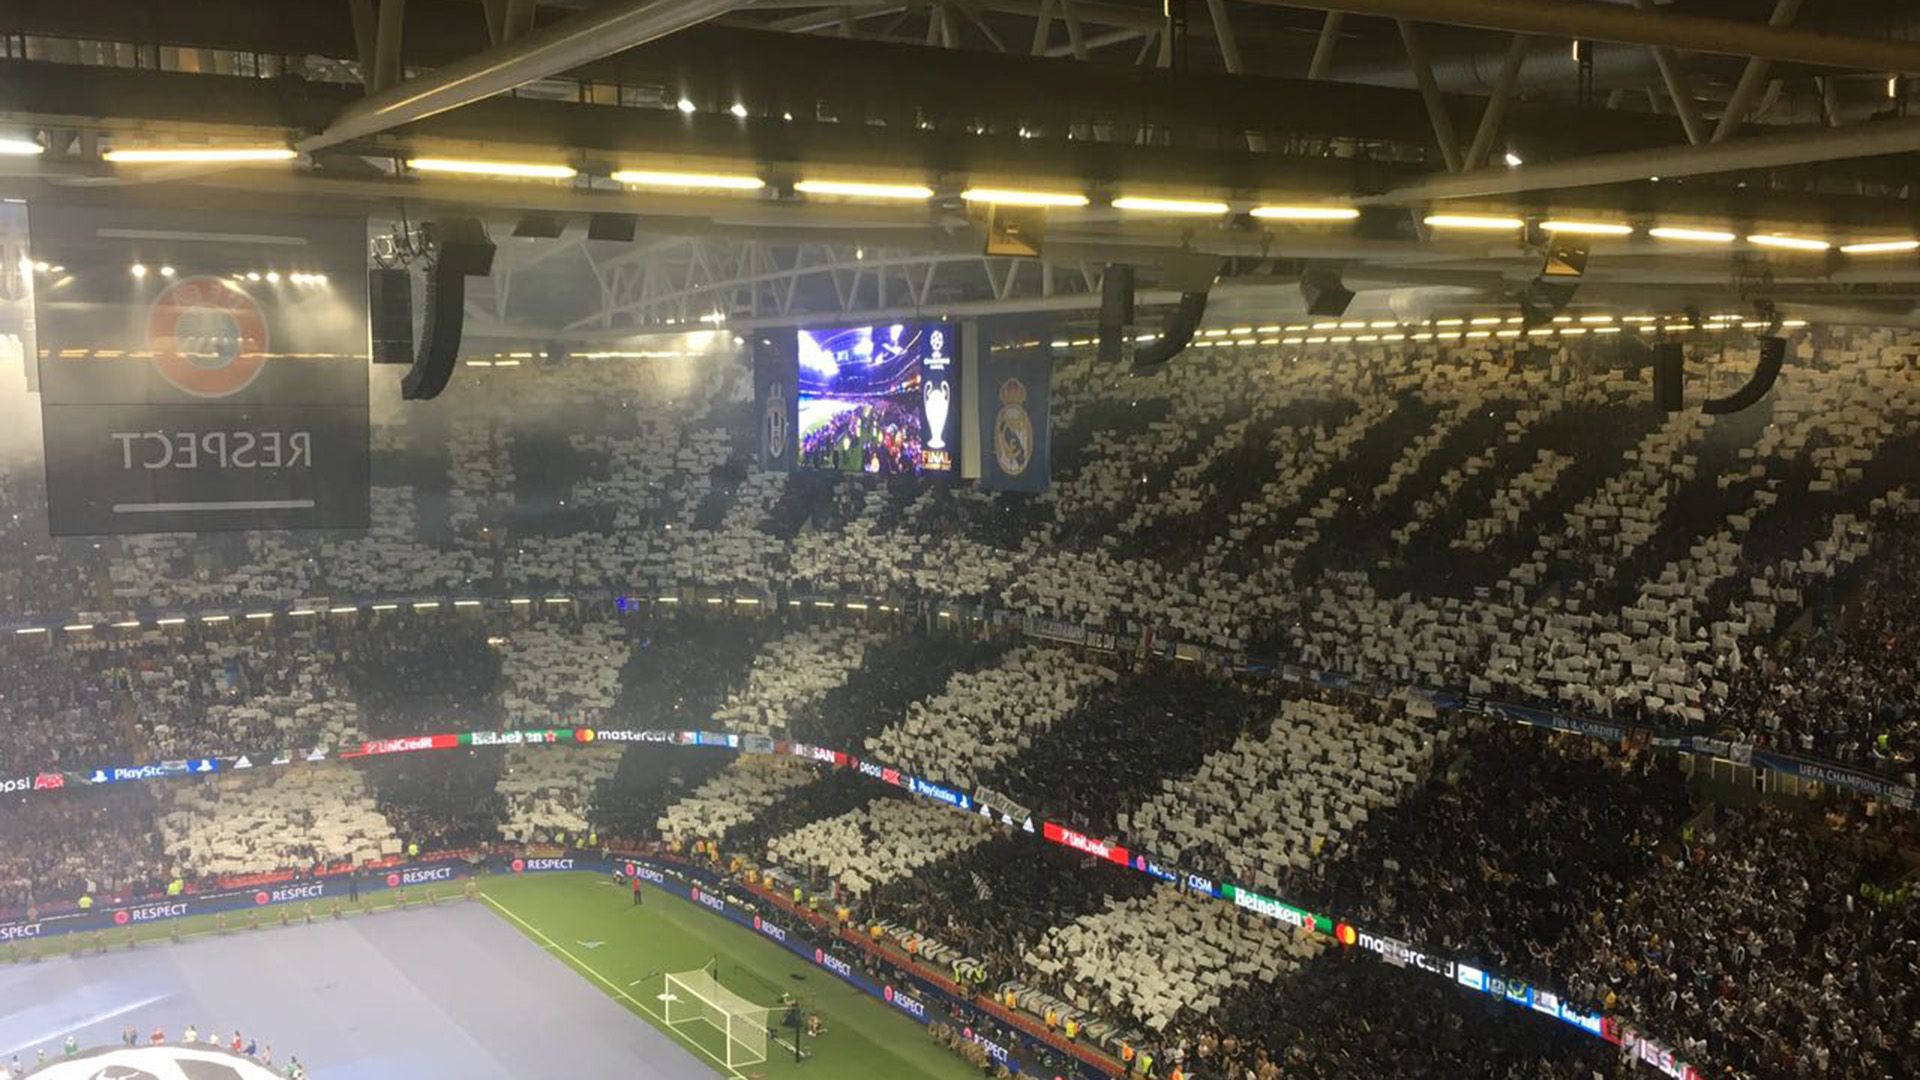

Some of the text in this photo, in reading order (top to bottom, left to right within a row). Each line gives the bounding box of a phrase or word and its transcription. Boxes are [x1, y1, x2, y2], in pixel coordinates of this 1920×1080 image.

[1552, 716, 1577, 730] FINL
[1800, 763, 1826, 779] UEFA
[1826, 770, 1882, 793] CHAMPIONS
[526, 859, 575, 870] RESPECT
[403, 868, 452, 883] RESPECT
[272, 884, 325, 901] RESPECT
[132, 903, 188, 920] RESPECT
[1234, 887, 1303, 927] Heineken
